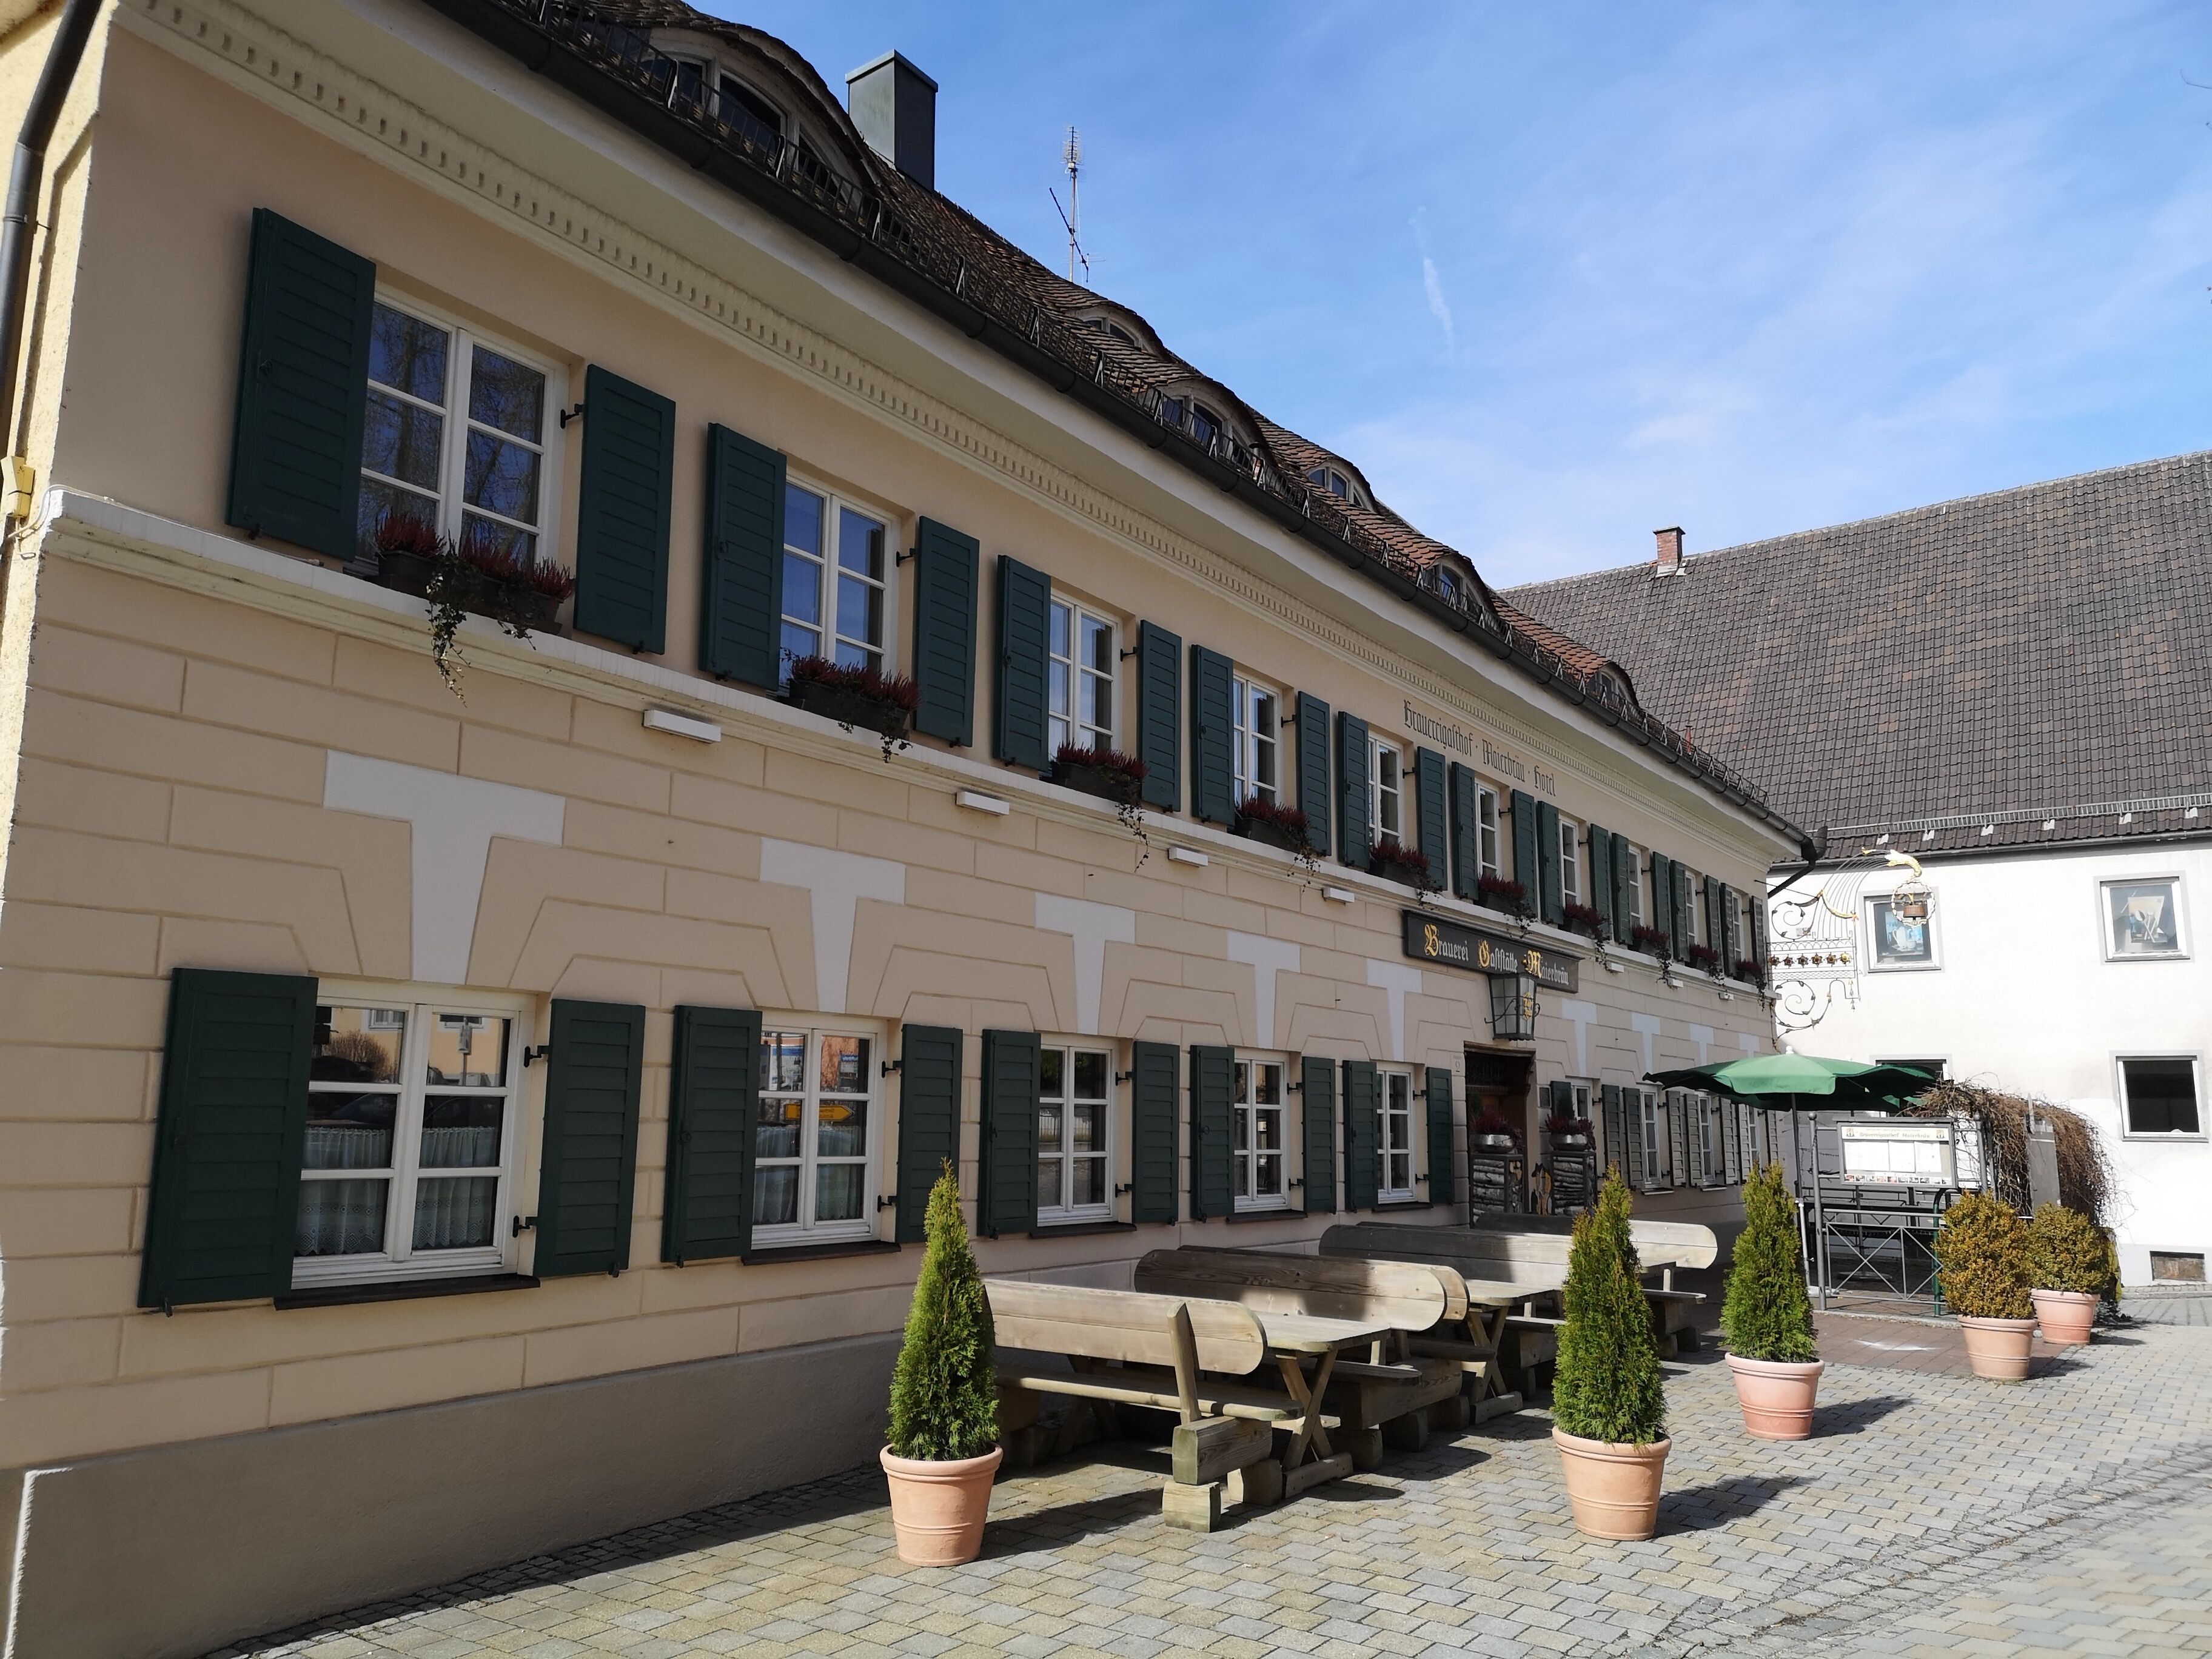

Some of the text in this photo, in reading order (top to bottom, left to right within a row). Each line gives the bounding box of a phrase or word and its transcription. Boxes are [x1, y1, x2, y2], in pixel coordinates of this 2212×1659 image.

[1403, 699, 1557, 797] Brauereigasthof Maierbräu Hotel
[1424, 923, 1469, 962] Brauerei
